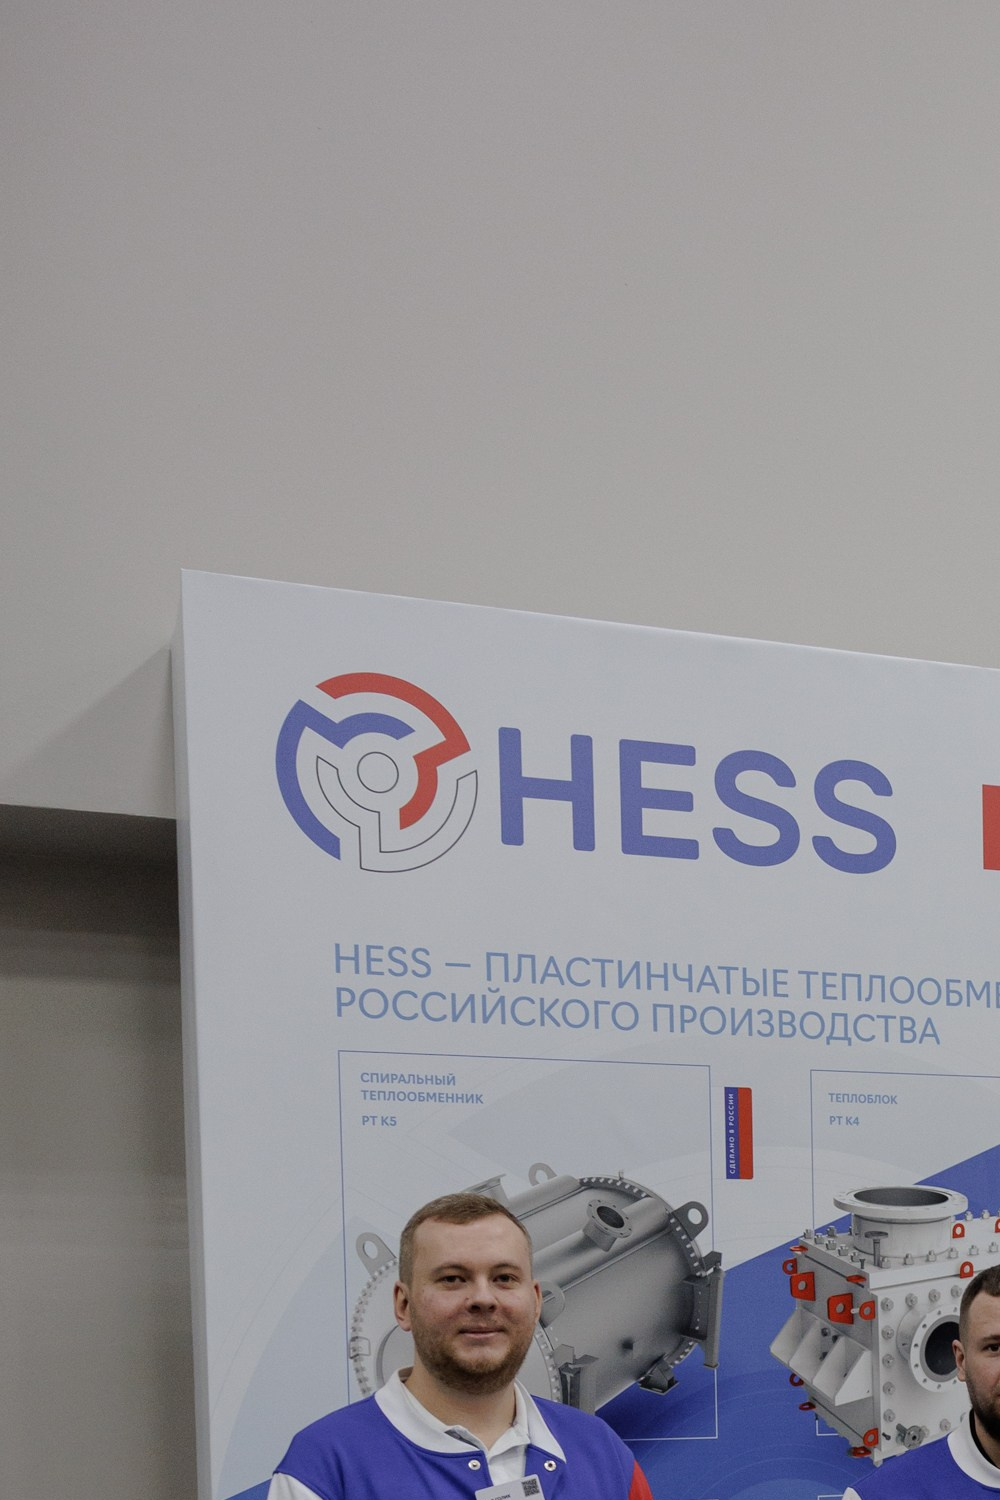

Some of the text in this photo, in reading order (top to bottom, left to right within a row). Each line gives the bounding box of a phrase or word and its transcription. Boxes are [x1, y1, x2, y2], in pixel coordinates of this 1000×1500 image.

[498, 726, 897, 875] HESS
[334, 942, 433, 979] HESS
[485, 951, 789, 998] ПЛАСТИНЧАТЫЕ
[335, 986, 941, 1047] РОССИЙСКОГО ПРОИЗВОДСТВА
[360, 1072, 456, 1086] СПИРАЛЬНЫЙ
[360, 1089, 484, 1105] ТЕПЛООБМЕННИК
[828, 1092, 898, 1105] ТЕПЛОБЛОК
